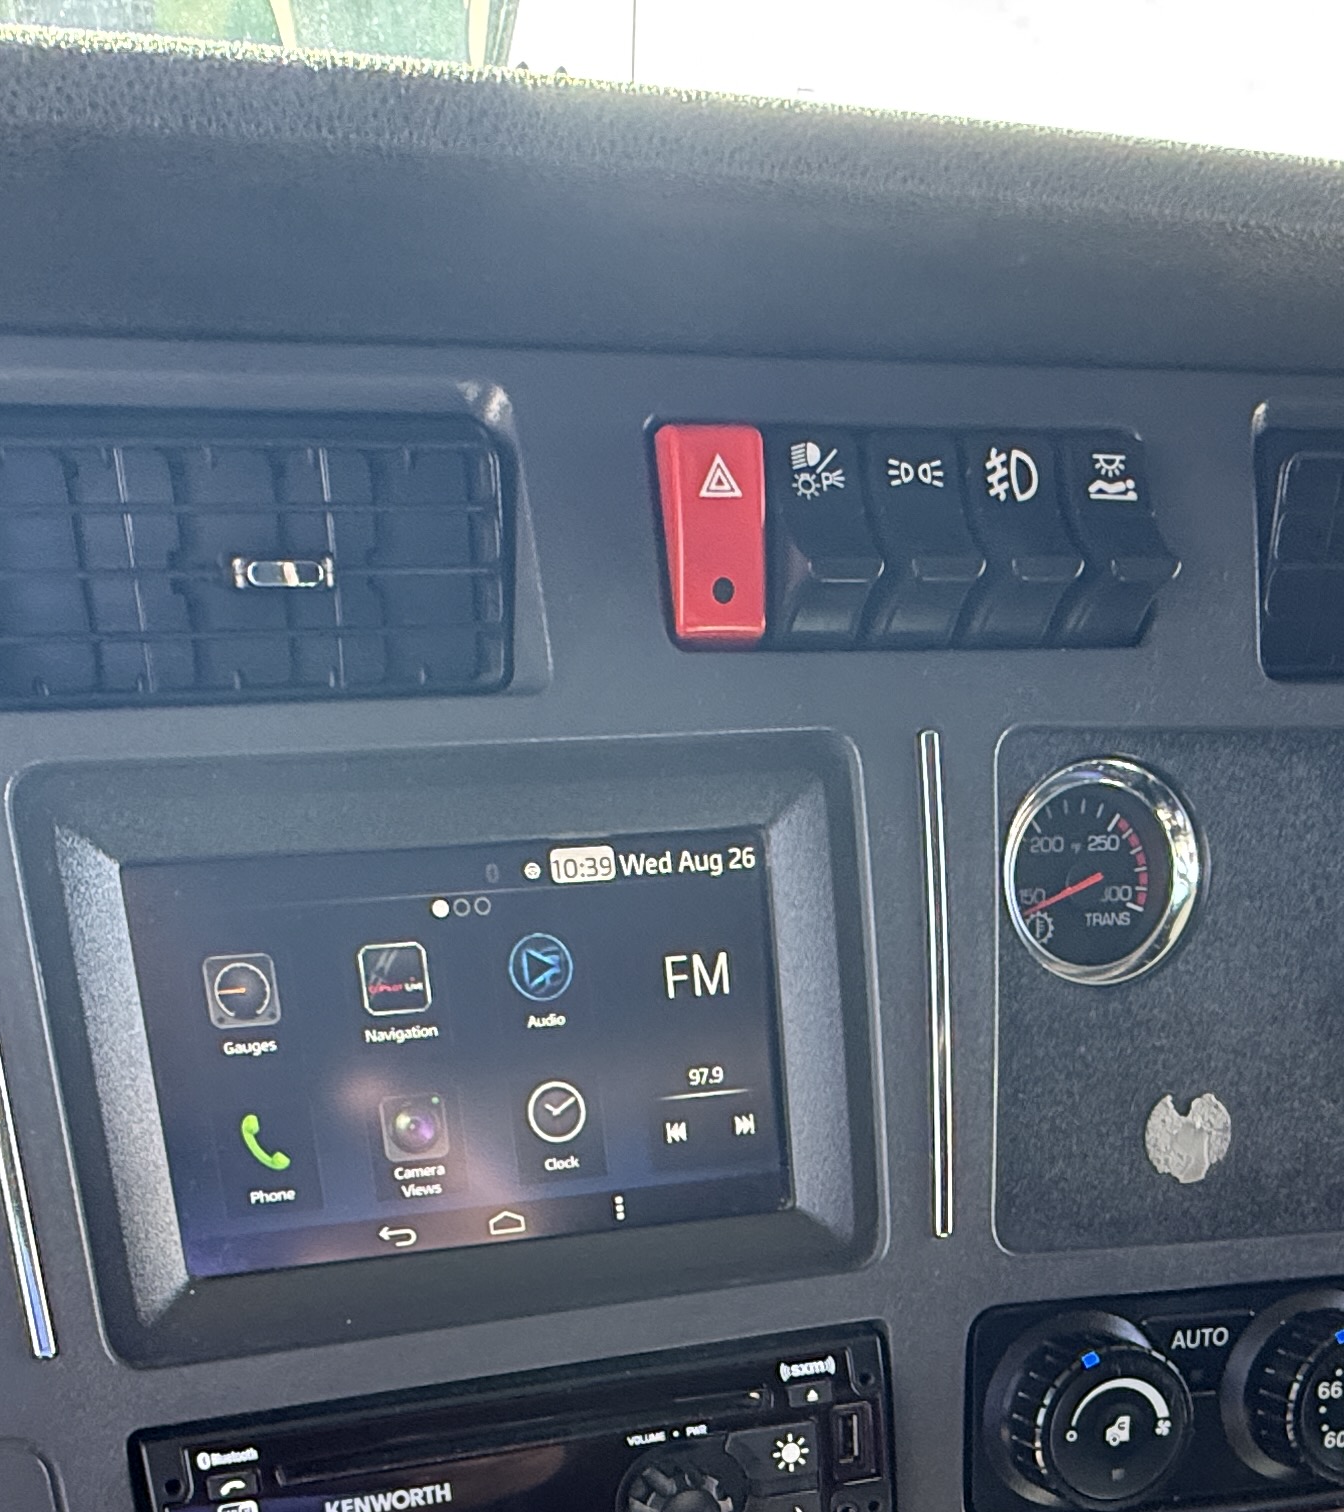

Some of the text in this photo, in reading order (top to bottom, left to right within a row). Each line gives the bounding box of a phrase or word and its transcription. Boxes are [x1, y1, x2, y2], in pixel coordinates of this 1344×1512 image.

[1030, 836, 1065, 854] 200
[1087, 834, 1121, 851] 250
[551, 847, 756, 880] 10:39 Wed Aug 26
[1084, 911, 1131, 927] TRANS
[664, 951, 731, 999] FM
[527, 1013, 567, 1029] Audio
[364, 1023, 440, 1044] Navigation
[222, 1039, 279, 1057] Gauges
[687, 1065, 725, 1086] 97.9
[393, 1162, 446, 1183] Camera
[543, 1155, 580, 1172] Clock
[249, 1188, 297, 1205] Phone
[400, 1181, 443, 1199] Views
[1170, 1326, 1230, 1350] AUTO
[1317, 1380, 1344, 1400] 66
